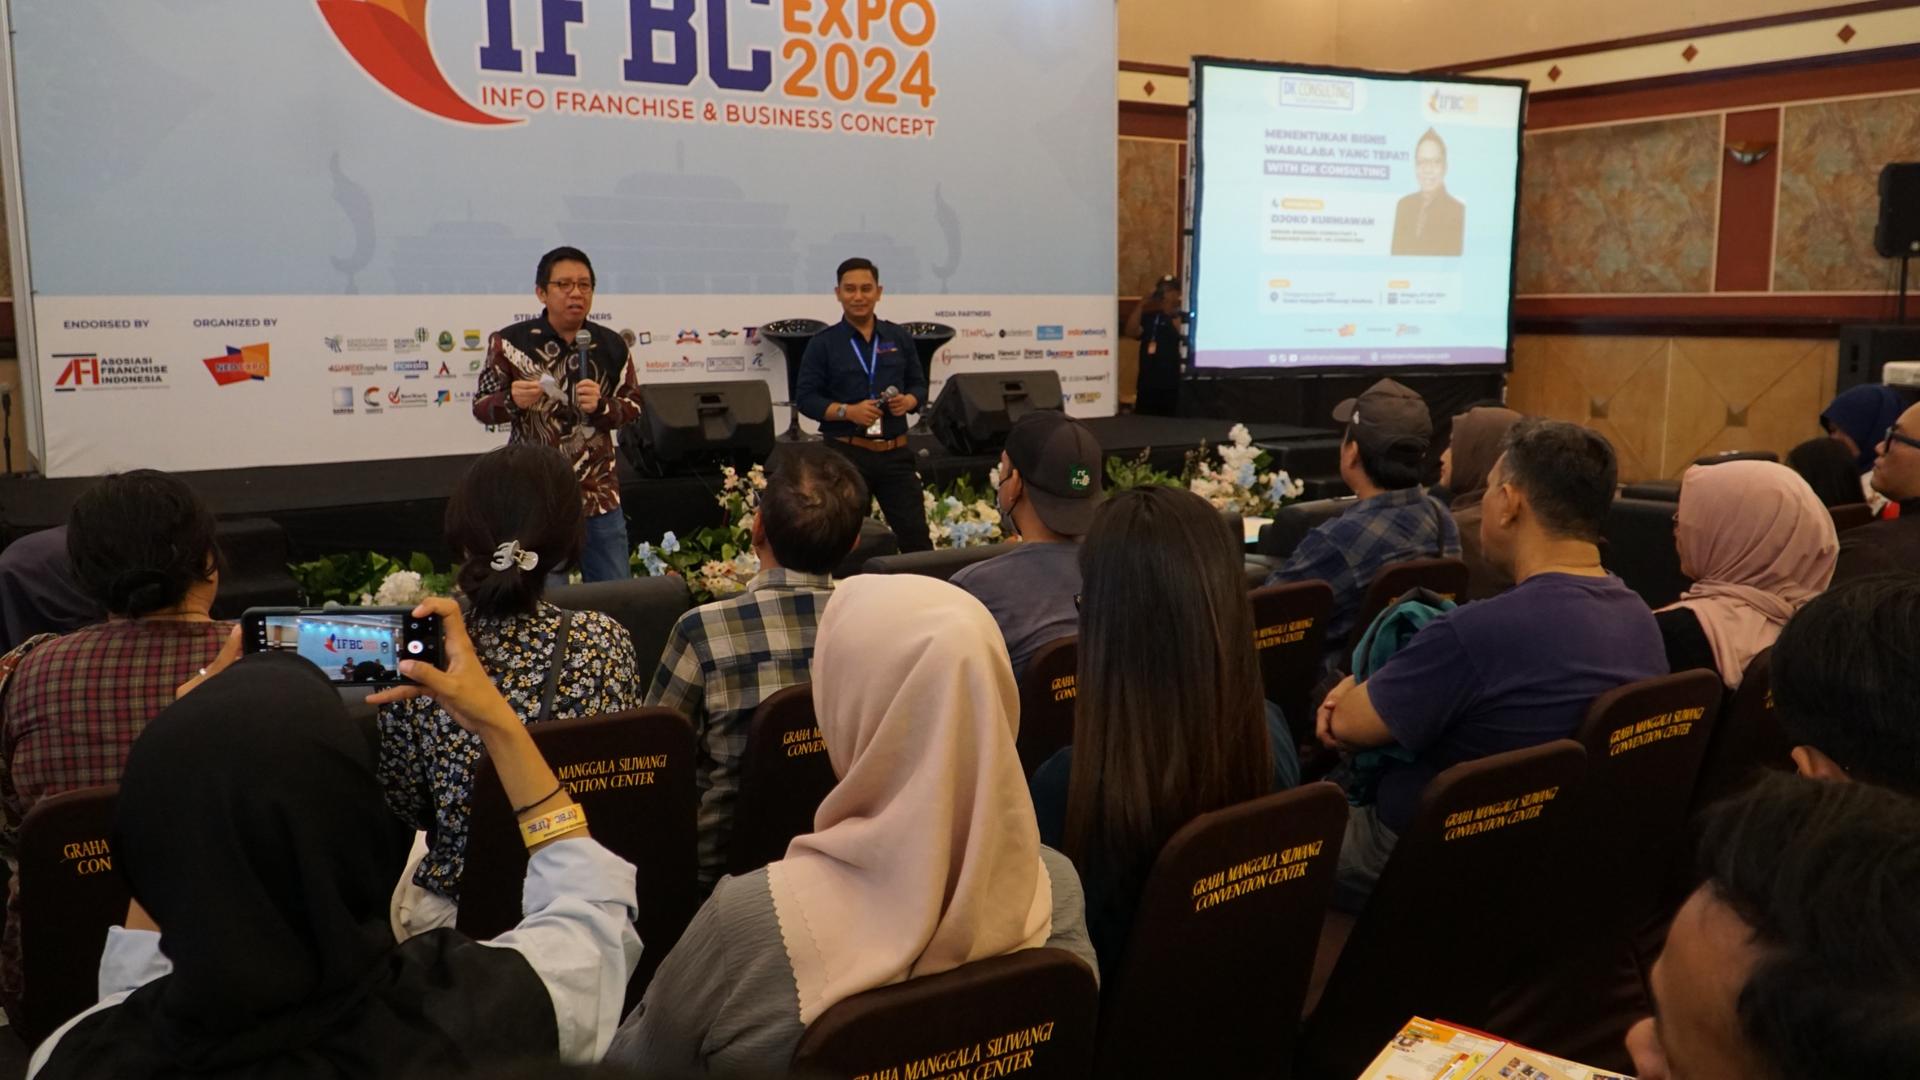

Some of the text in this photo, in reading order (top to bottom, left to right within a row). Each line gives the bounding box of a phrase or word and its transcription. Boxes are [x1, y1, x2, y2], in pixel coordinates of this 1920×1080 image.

[783, 0, 935, 46] EXPO
[480, 0, 772, 92] IFBC
[783, 39, 936, 108] 2024
[482, 86, 935, 136] INFO FRANCHISE & BUSINESS CONCEPT
[1265, 129, 1386, 144] MENENTUKAN BISNIS
[1340, 148, 1370, 160] YANG
[1267, 163, 1387, 177] WITH DK CONSULTING
[1271, 215, 1308, 225] DJOKO
[64, 320, 150, 329] ENDORSED BY
[193, 318, 278, 328] ORGANIZED BY
[589, 313, 612, 321] NERS
[101, 357, 152, 365] ASOSIASI
[101, 366, 168, 374] FRANCHISE
[101, 375, 163, 384] INDONESIA
[337, 638, 363, 650] IFBC
[783, 728, 810, 744] GRAHA
[1610, 723, 1692, 756] CONVENTION CENTER
[787, 740, 827, 757] CONVEN
[558, 754, 668, 780] MANGGALA SILIWANGI
[563, 771, 655, 795] ENTION CENTER
[1445, 804, 1544, 841] CONVENTION CENTER
[64, 838, 110, 859] GRAHA
[1193, 840, 1324, 896] GRAHA MANGGALA SILIWANGI
[1195, 861, 1308, 913] CONVENTION CENTER
[904, 1043, 981, 1080] MANGGALA
[987, 1021, 1055, 1058] SILIWANGI
[974, 1049, 1035, 1080] CENTER
